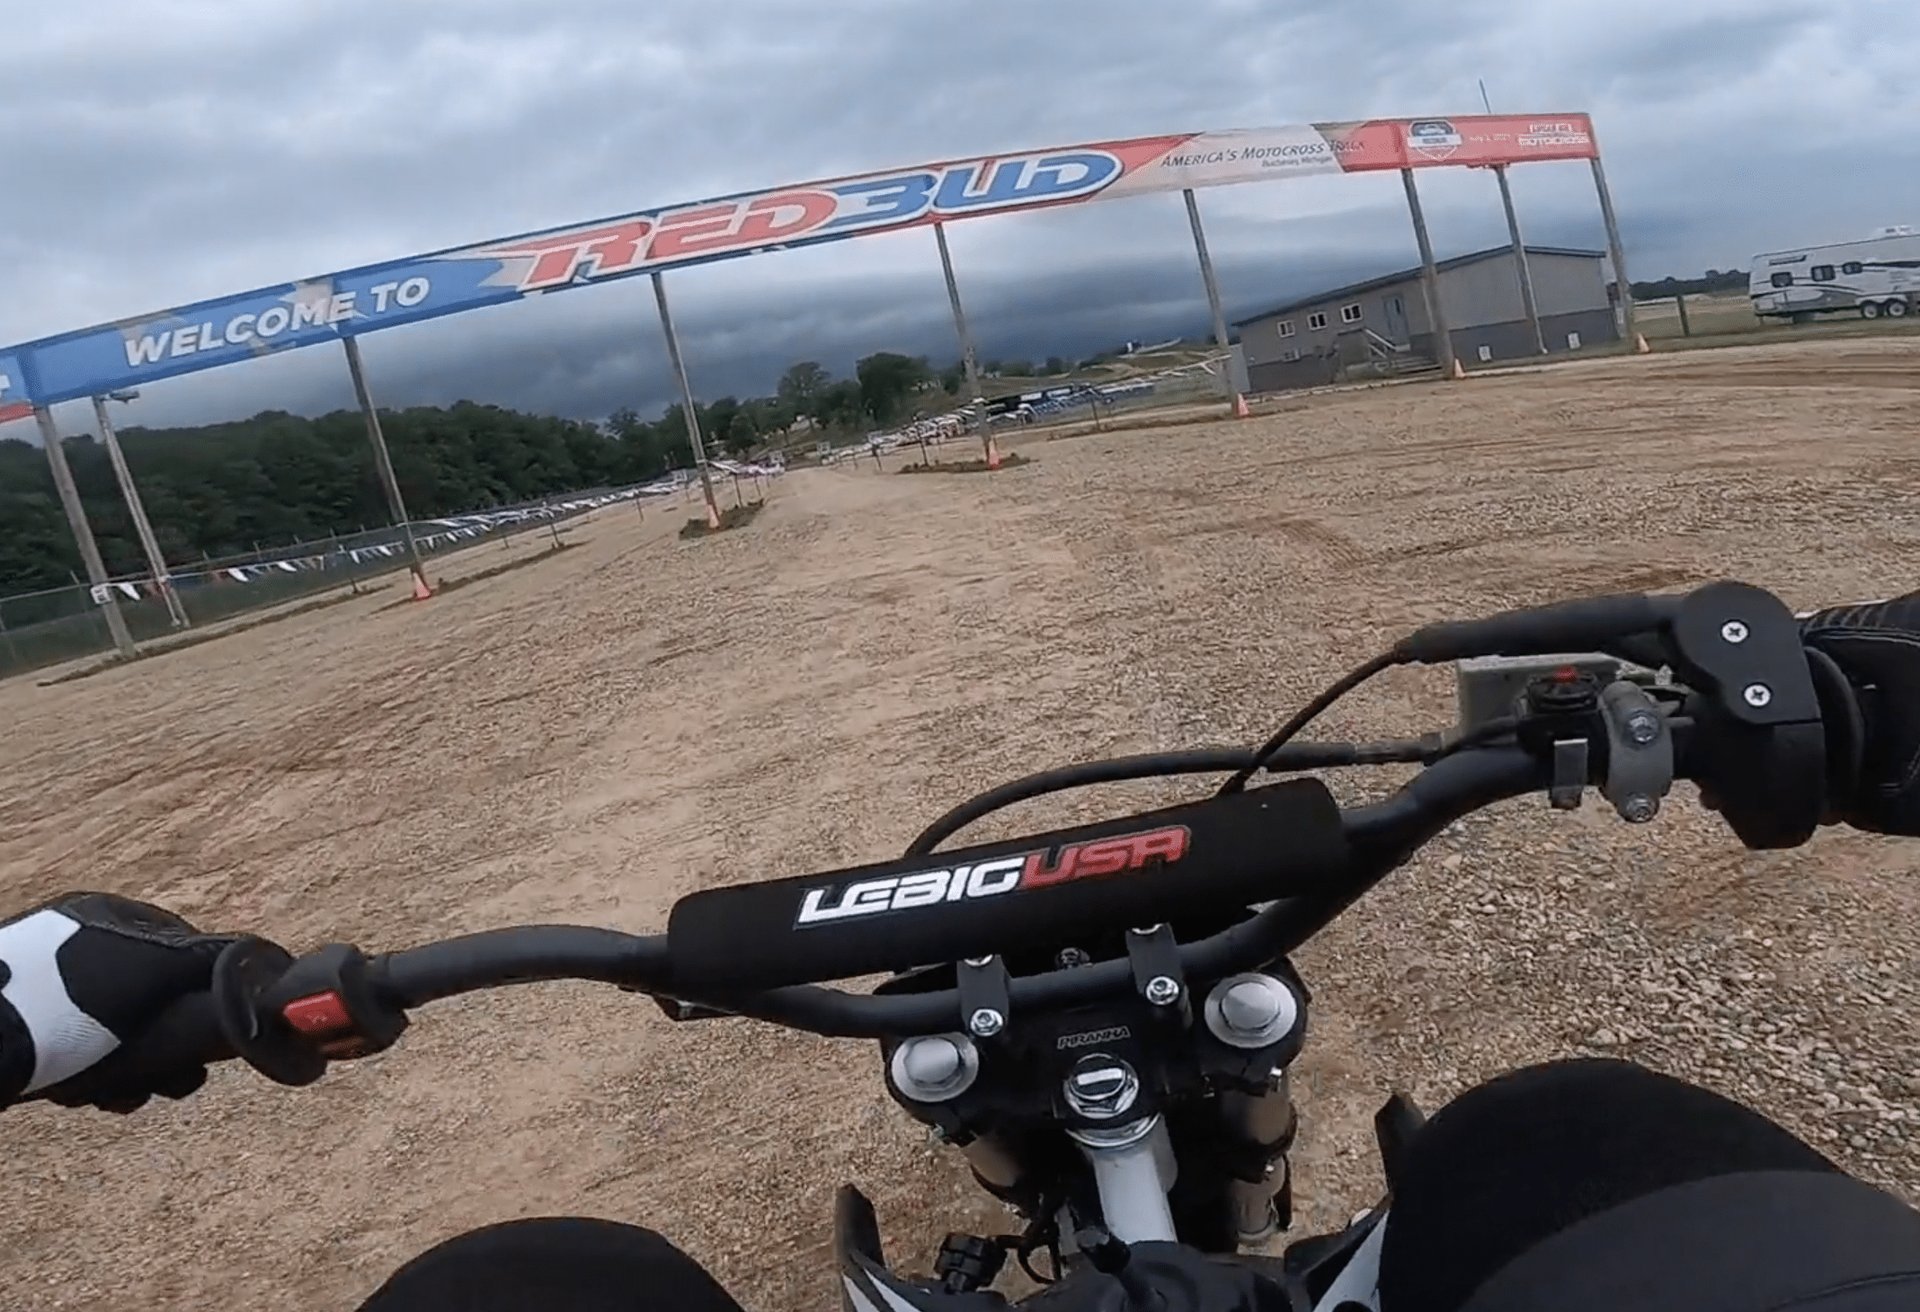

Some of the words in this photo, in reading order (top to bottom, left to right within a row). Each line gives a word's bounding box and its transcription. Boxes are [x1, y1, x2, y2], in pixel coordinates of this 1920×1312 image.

[1160, 149, 1238, 167] AMERICA'S
[1241, 142, 1324, 160] MOTOCROSS
[124, 291, 356, 367] WELCOME
[370, 276, 430, 314] TO
[1057, 1025, 1131, 1050] PIRANHA
